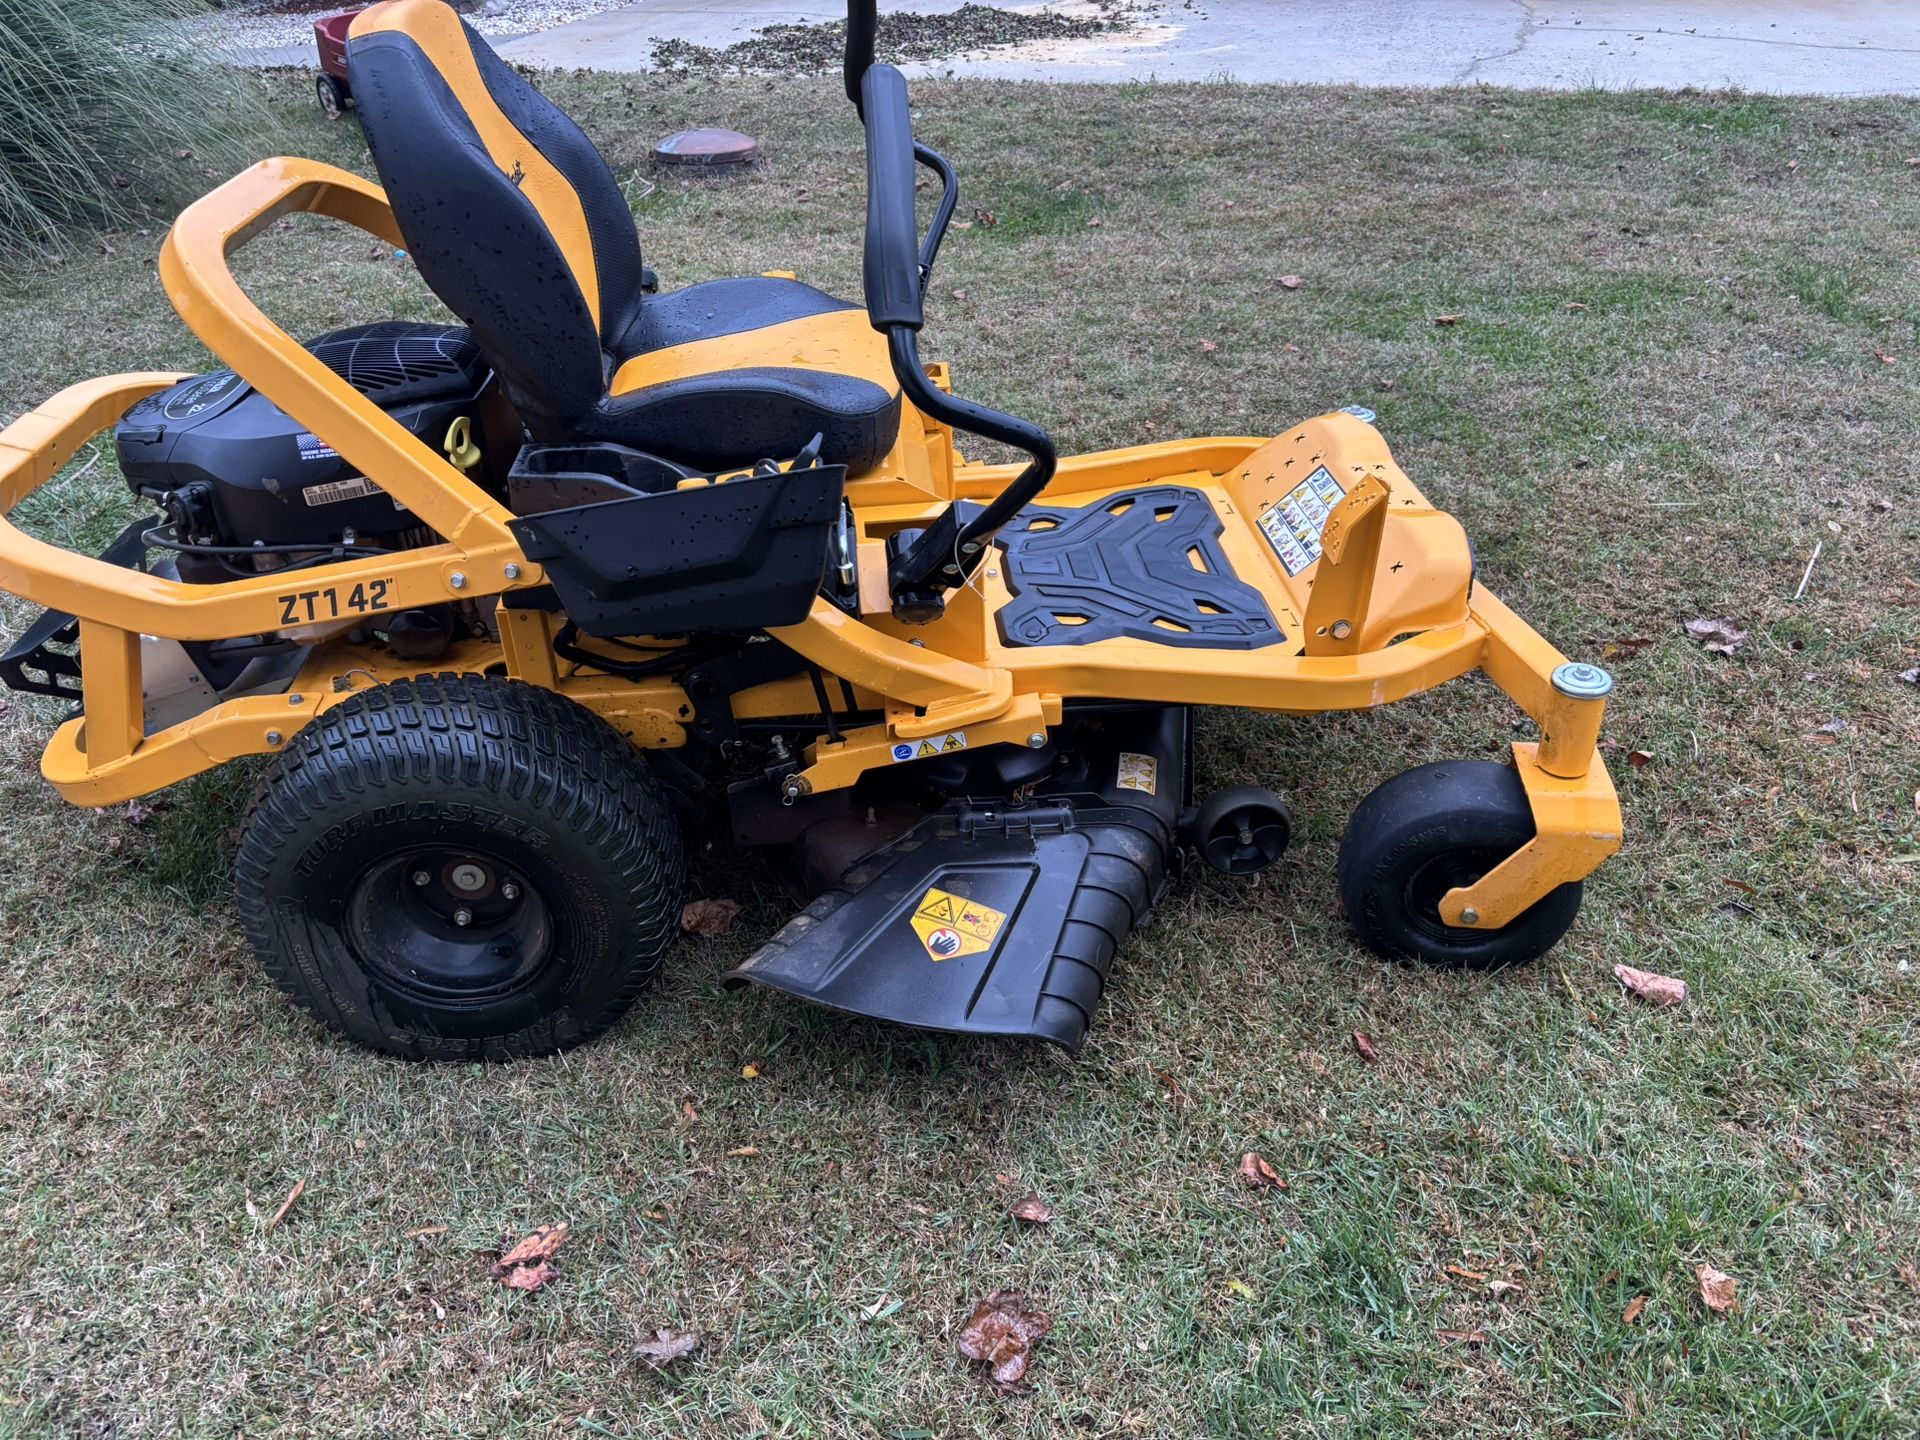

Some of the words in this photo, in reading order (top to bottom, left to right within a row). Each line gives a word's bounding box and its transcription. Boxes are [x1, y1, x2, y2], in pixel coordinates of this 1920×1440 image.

[278, 587, 338, 625] ZT1
[348, 577, 393, 612] 42"
[290, 811, 364, 878] TURF
[372, 800, 550, 849] MASTER
